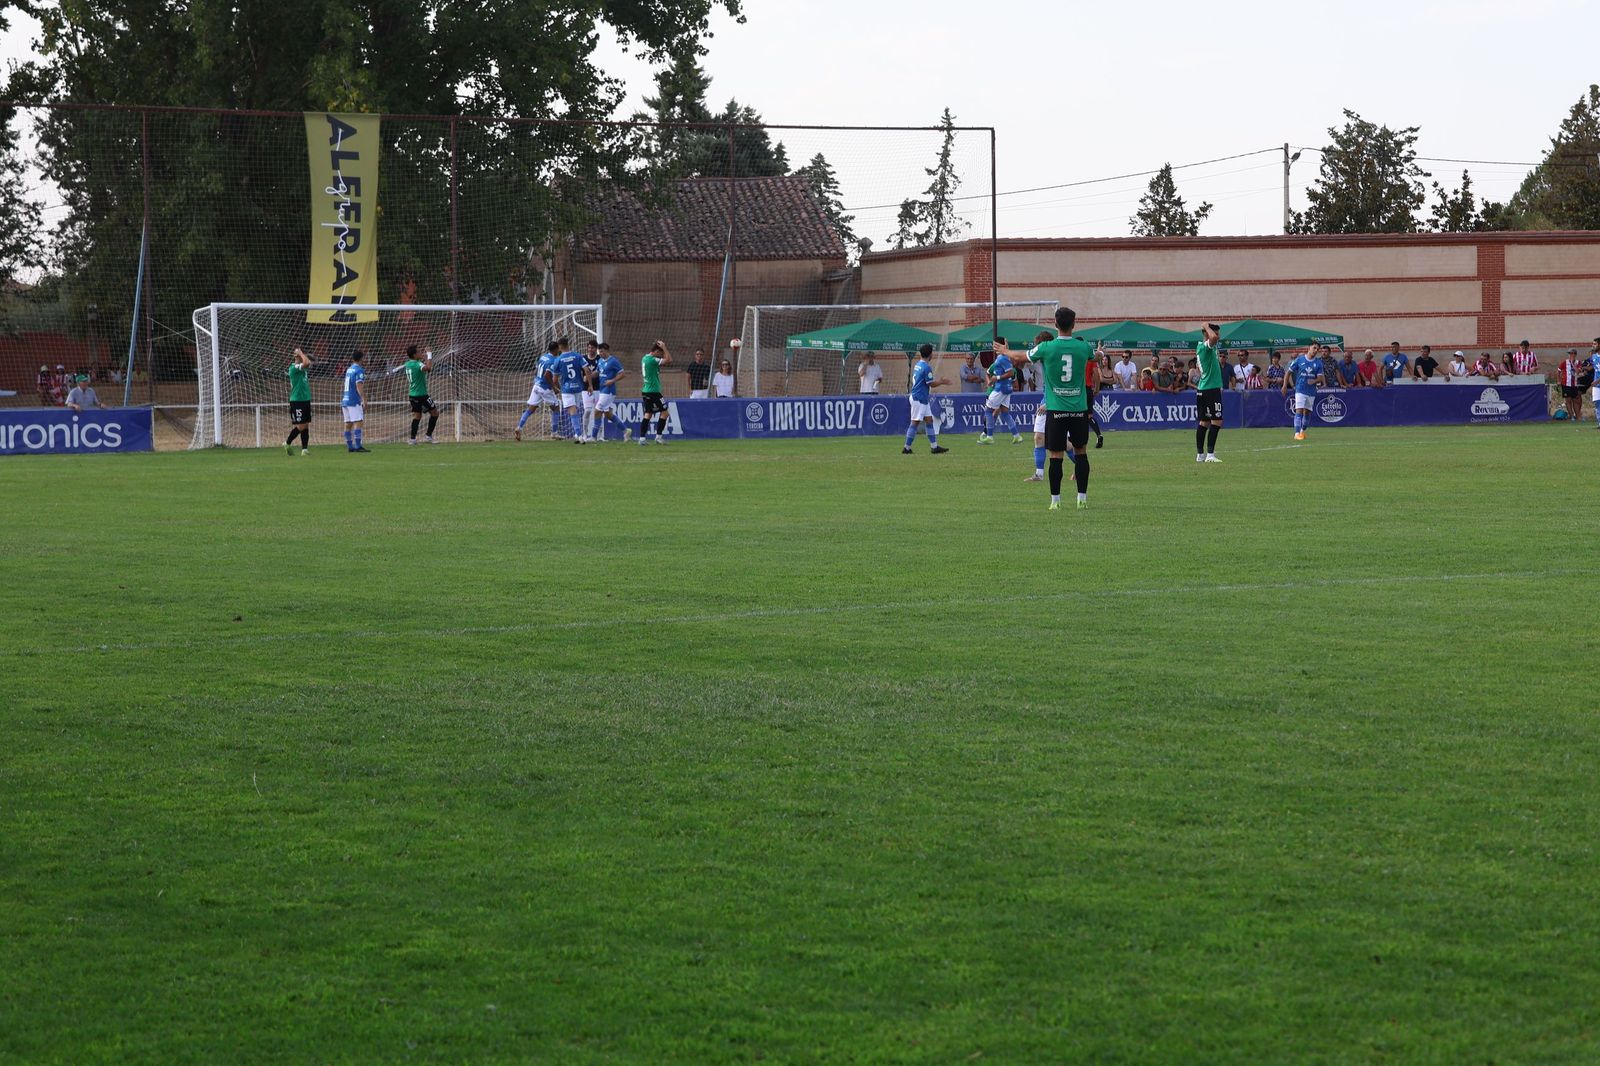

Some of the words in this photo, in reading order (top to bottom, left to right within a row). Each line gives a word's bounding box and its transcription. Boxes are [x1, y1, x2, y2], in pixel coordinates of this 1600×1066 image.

[326, 114, 361, 322] ALEFRAN
[566, 363, 576, 379] 5
[1061, 354, 1073, 382] 3
[769, 400, 865, 431] IMPULSO27
[1122, 405, 1165, 424] CAJA
[1214, 402, 1221, 412] 10
[1321, 402, 1341, 411] Estrella
[0, 415, 122, 449] ronics
